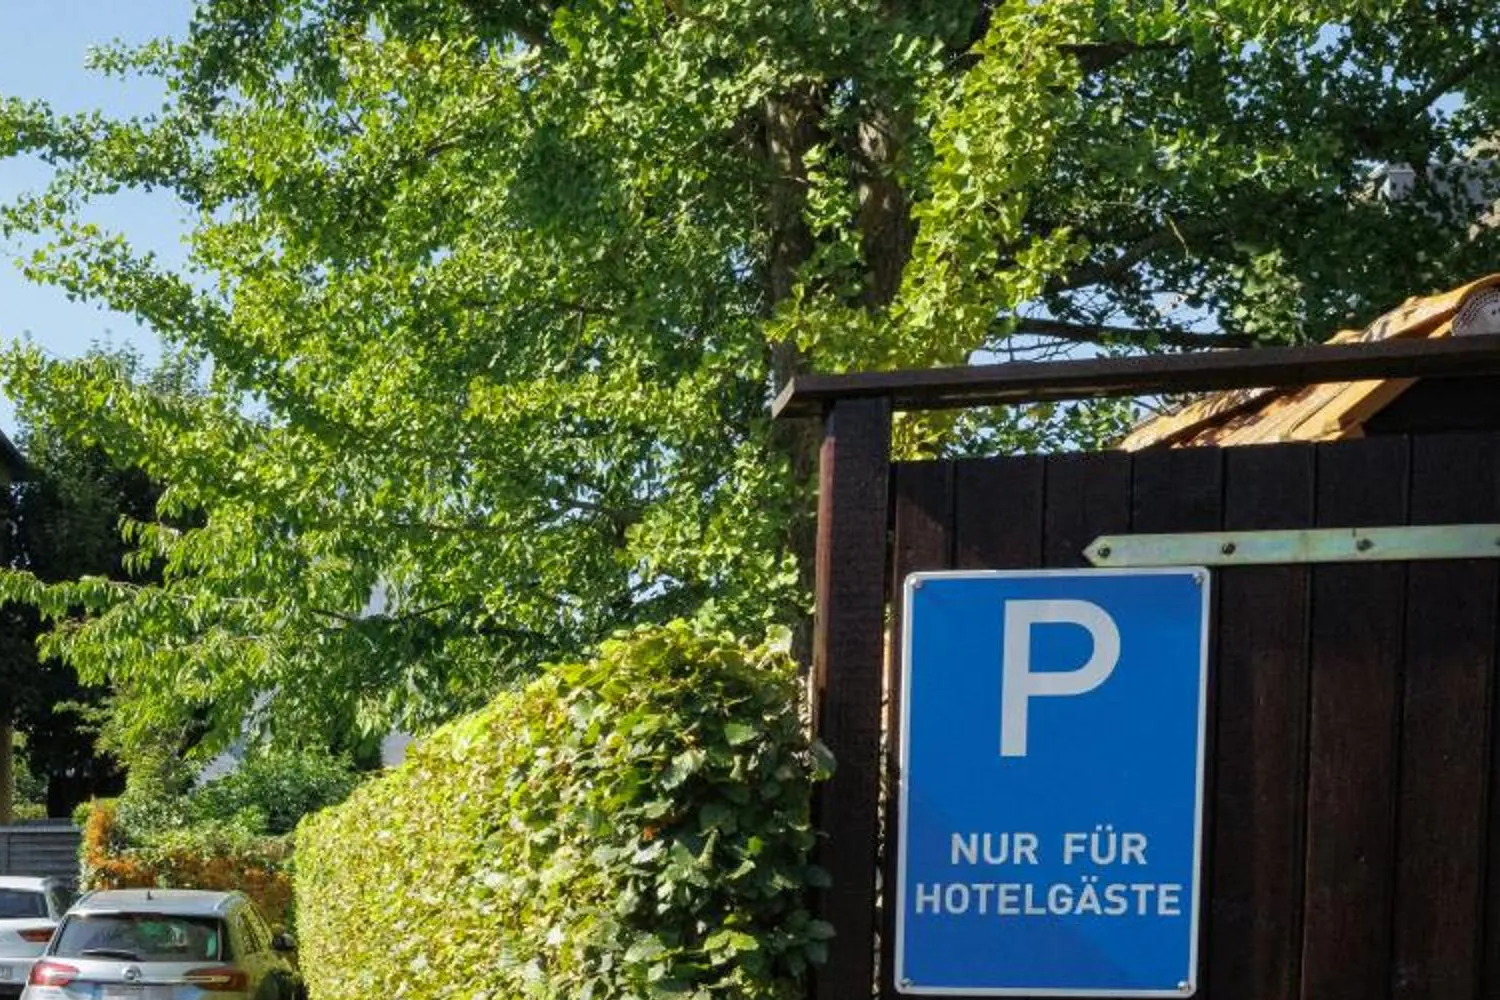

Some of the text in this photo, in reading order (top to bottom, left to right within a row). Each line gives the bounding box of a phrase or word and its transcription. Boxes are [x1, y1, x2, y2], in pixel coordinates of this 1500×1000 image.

[1000, 599, 1121, 757] P
[951, 824, 1148, 866] NUR FÜR
[914, 875, 1182, 917] HOTELGÄSTE
